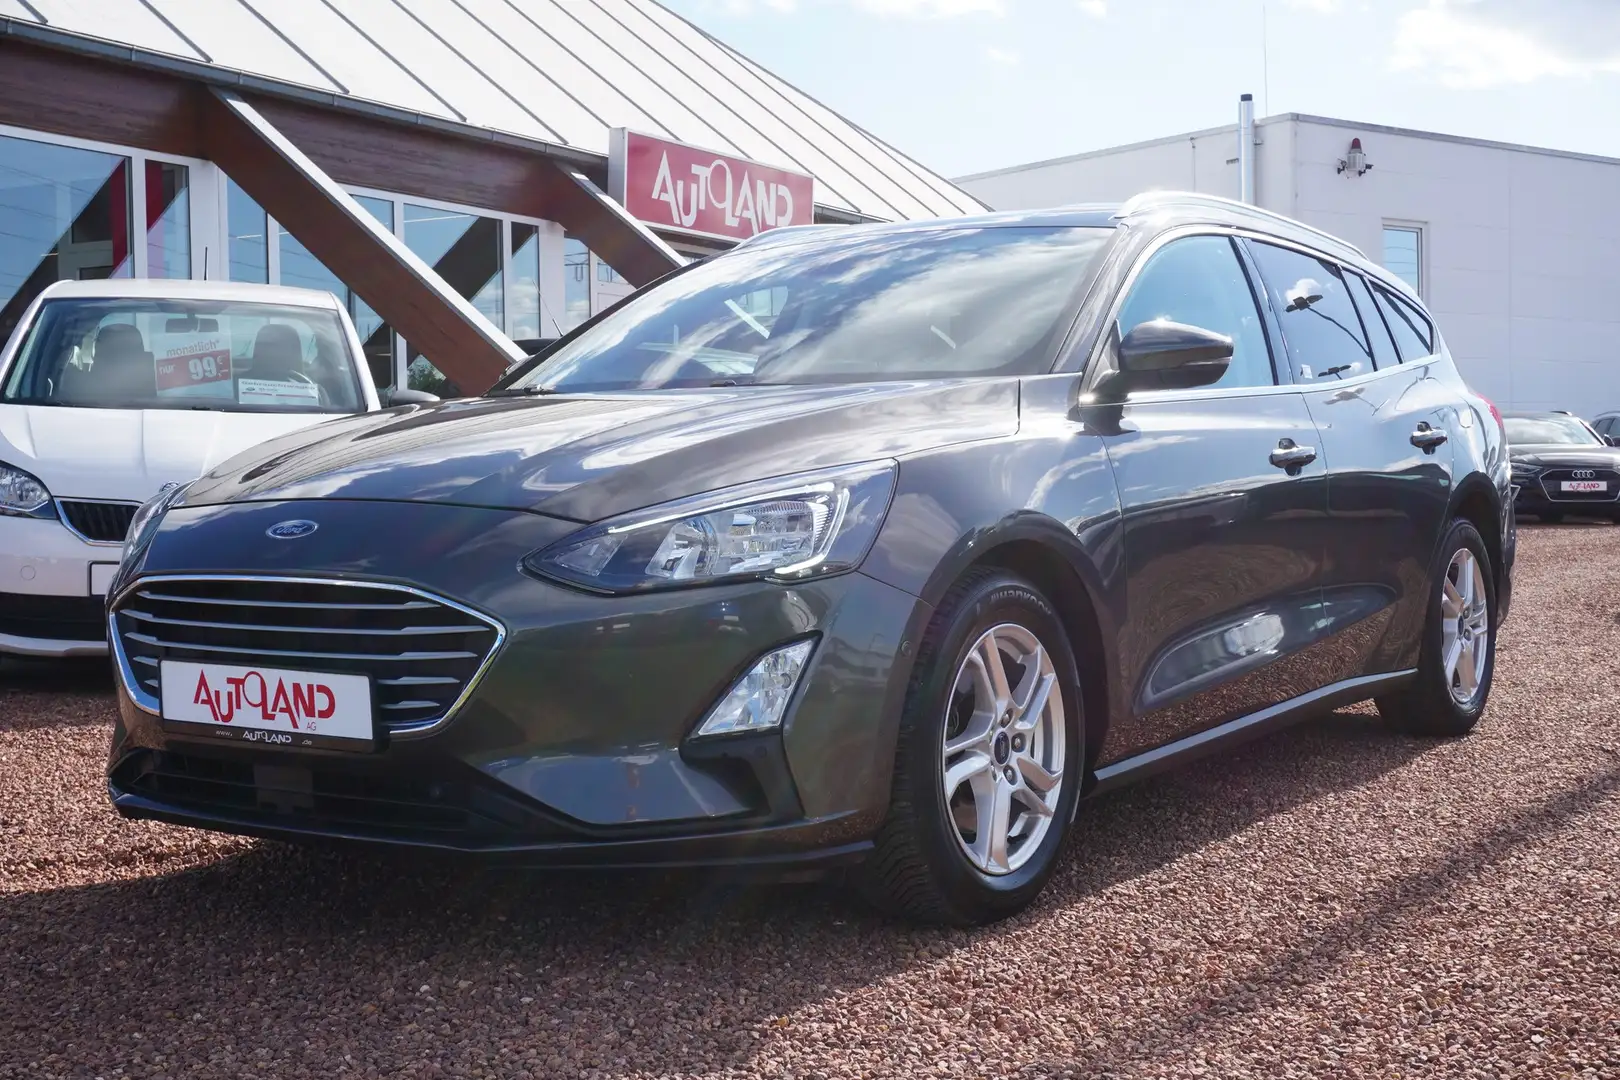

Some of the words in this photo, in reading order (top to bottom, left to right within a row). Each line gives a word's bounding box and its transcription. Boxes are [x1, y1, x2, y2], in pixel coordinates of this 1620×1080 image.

[652, 150, 794, 236] AUTOLAND
[159, 363, 176, 375] nur
[193, 669, 336, 730] AUTOLAND
[305, 721, 317, 732] AG
[242, 730, 292, 744] AUTOLAND
